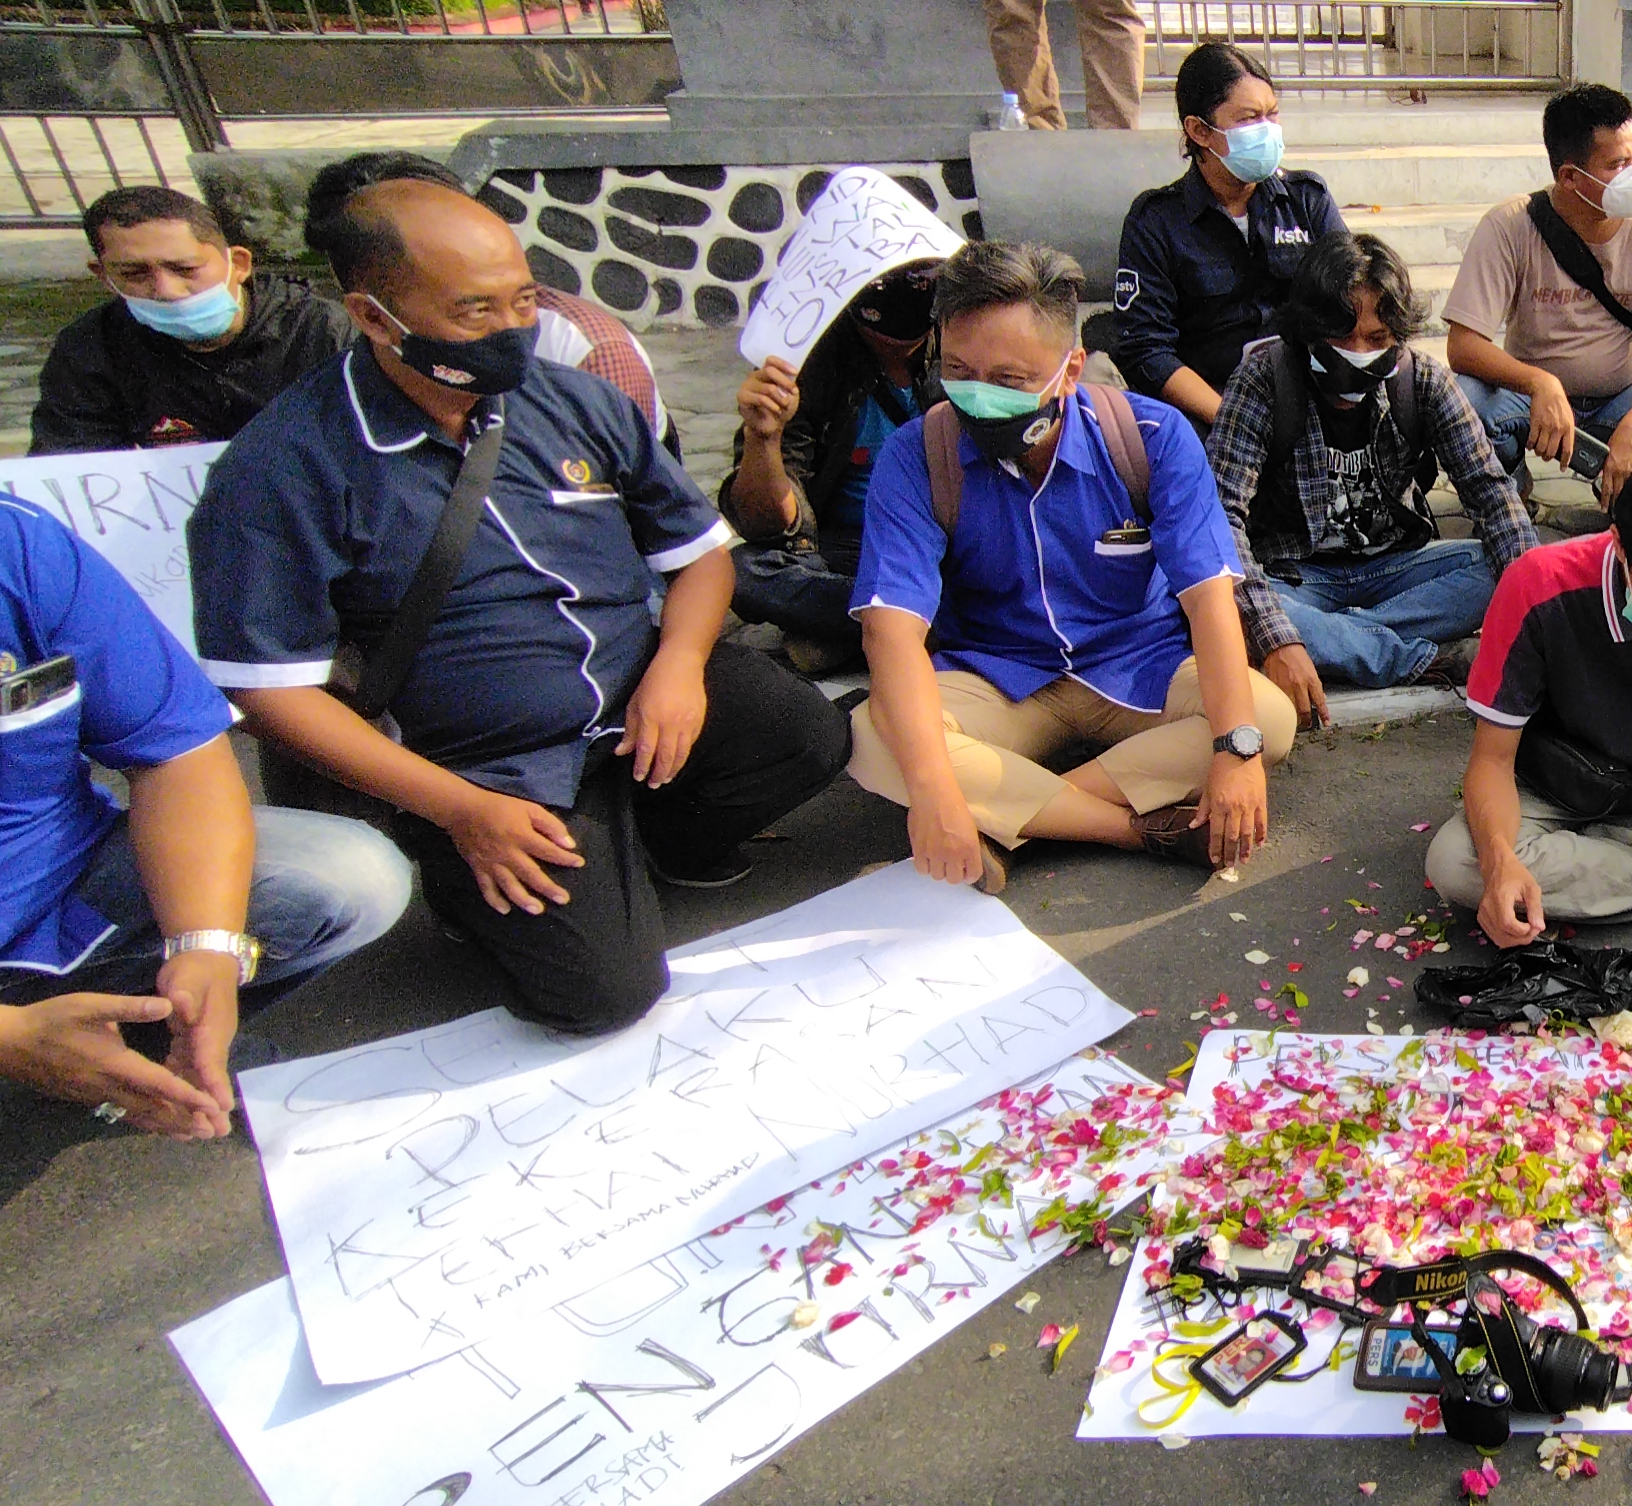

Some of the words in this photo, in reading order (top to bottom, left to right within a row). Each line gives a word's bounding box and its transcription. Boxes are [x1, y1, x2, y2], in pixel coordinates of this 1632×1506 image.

[1274, 226, 1309, 244] kstv
[385, 951, 888, 1189] PELAKU
[1415, 1270, 1468, 1293] Nikon
[1368, 1337, 1383, 1368] PERS
